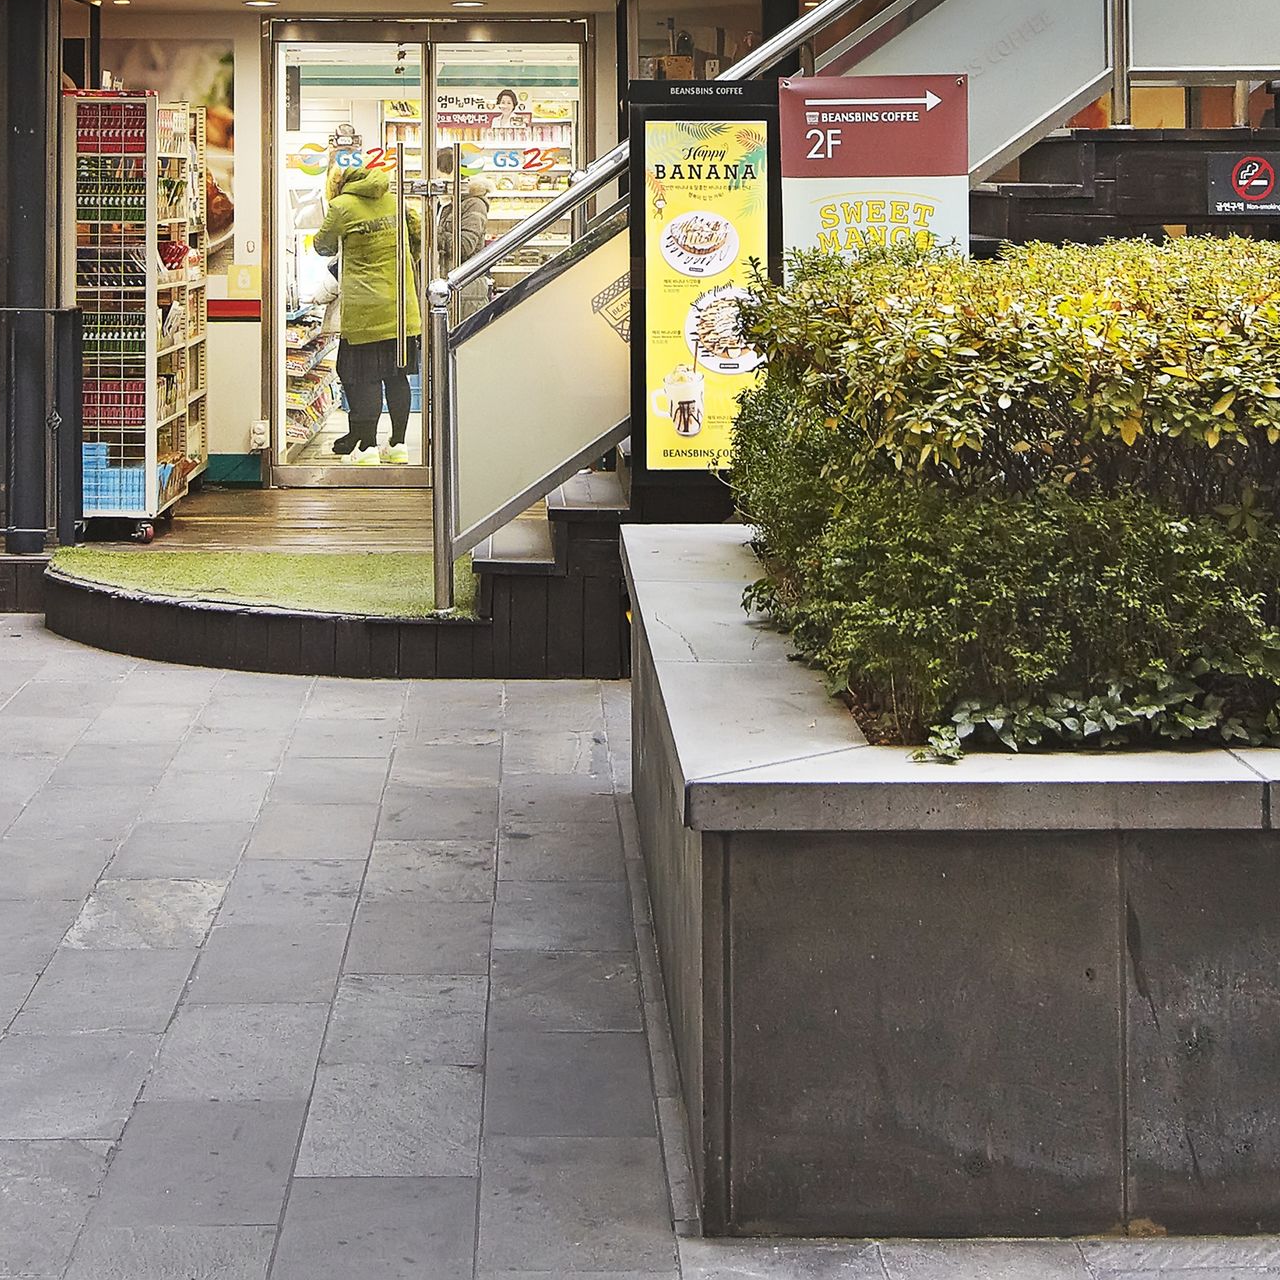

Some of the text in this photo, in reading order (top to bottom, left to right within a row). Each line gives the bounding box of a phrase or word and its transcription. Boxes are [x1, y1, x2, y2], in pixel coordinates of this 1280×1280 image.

[670, 87, 744, 95] BEANSBINS COFFEE
[822, 112, 919, 122] BEANSBINS COFFEE
[805, 129, 842, 159] 2F
[492, 147, 561, 173] GS25
[682, 144, 728, 162] Happy
[655, 164, 758, 179] BANANA
[1215, 202, 1245, 212] 금연구역
[819, 200, 936, 230] SWEET
[663, 449, 715, 458] BEANSBINS
